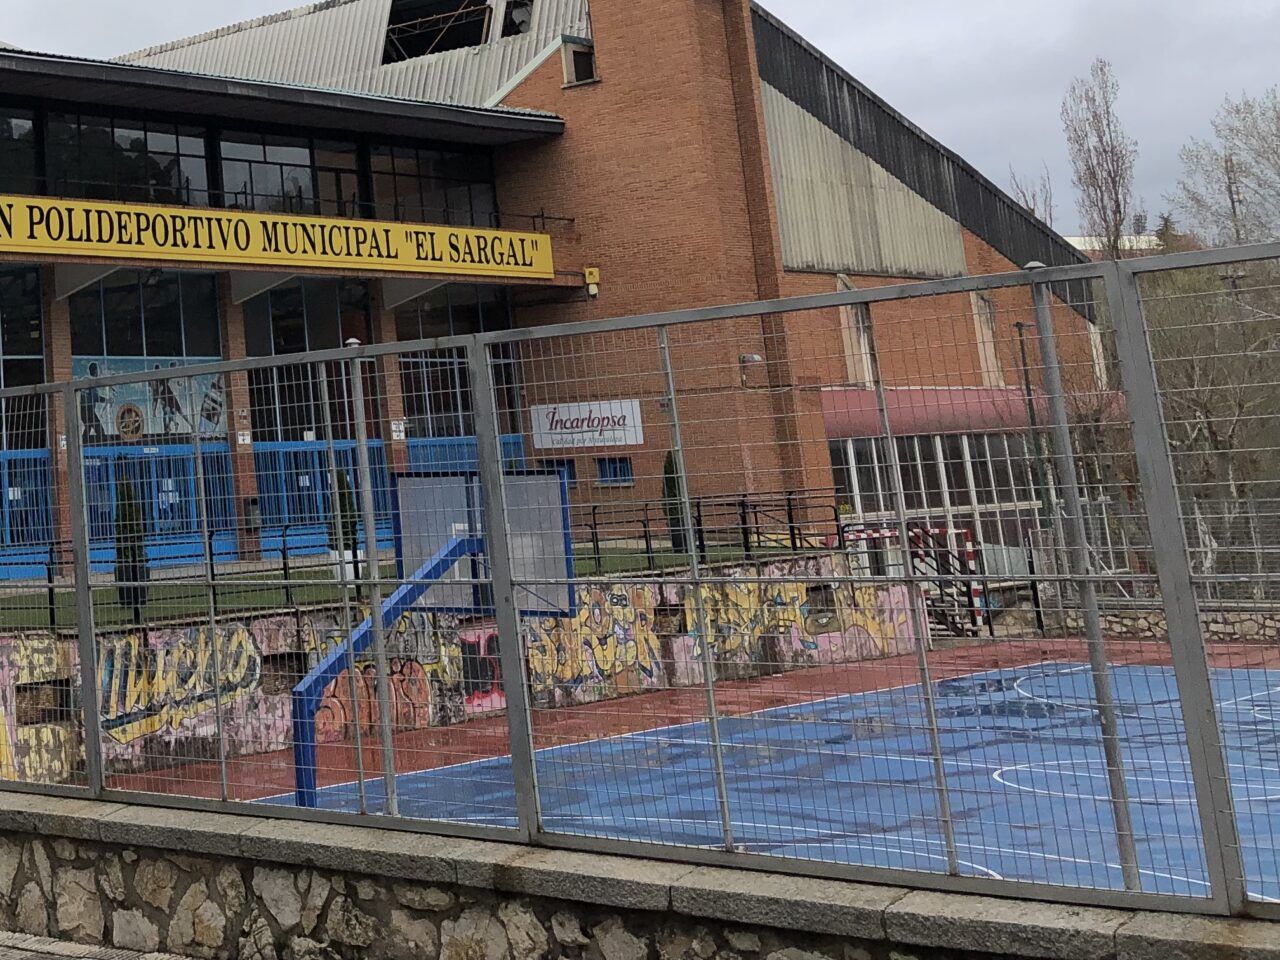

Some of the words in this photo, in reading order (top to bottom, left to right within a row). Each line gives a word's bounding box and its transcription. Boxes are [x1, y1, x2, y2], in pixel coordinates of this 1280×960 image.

[26, 204, 251, 251] POLIDEPORTIVO
[260, 220, 399, 259] MUNICIPAL
[405, 231, 443, 262] "EL
[449, 235, 538, 267] SARGAL"
[546, 407, 627, 436] Incarlopsa
